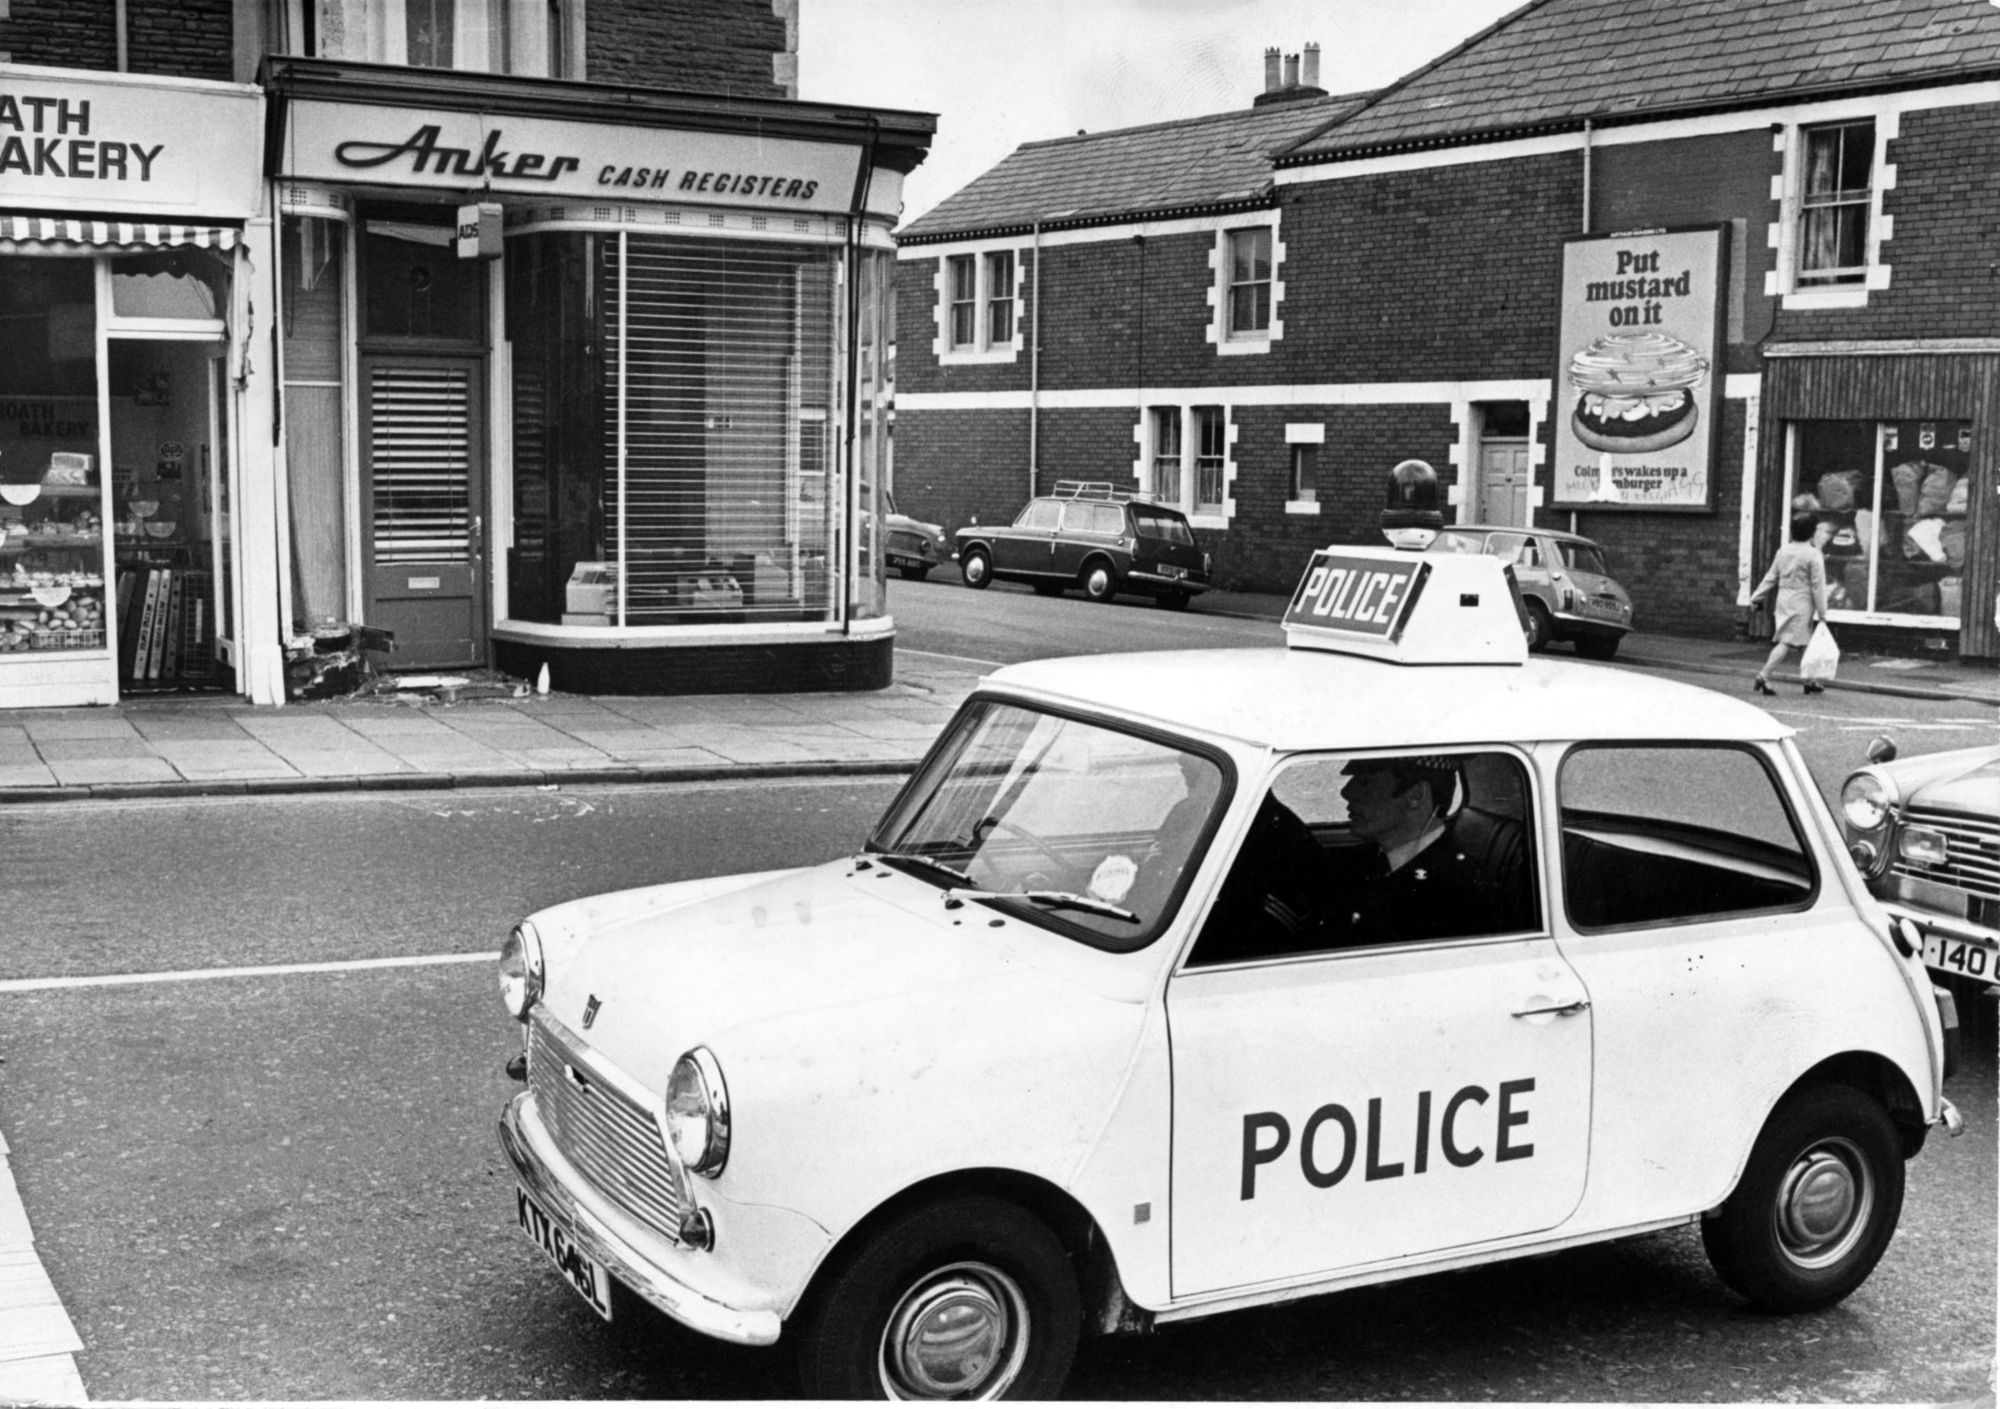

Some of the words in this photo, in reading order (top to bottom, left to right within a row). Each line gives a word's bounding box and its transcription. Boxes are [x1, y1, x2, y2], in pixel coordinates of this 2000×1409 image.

[335, 124, 580, 182] Anker
[597, 165, 670, 189] CASH
[679, 171, 819, 200] REGISTERS
[1616, 249, 1660, 275] Put
[1586, 270, 1691, 302] mustard
[1609, 306, 1640, 327] on
[1643, 300, 1662, 325] it
[1624, 465, 1662, 478] wakes
[1664, 467, 1679, 481] up
[1680, 467, 1688, 478] a
[1294, 566, 1408, 624] POLICE
[1240, 1077, 1536, 1201] POLICE
